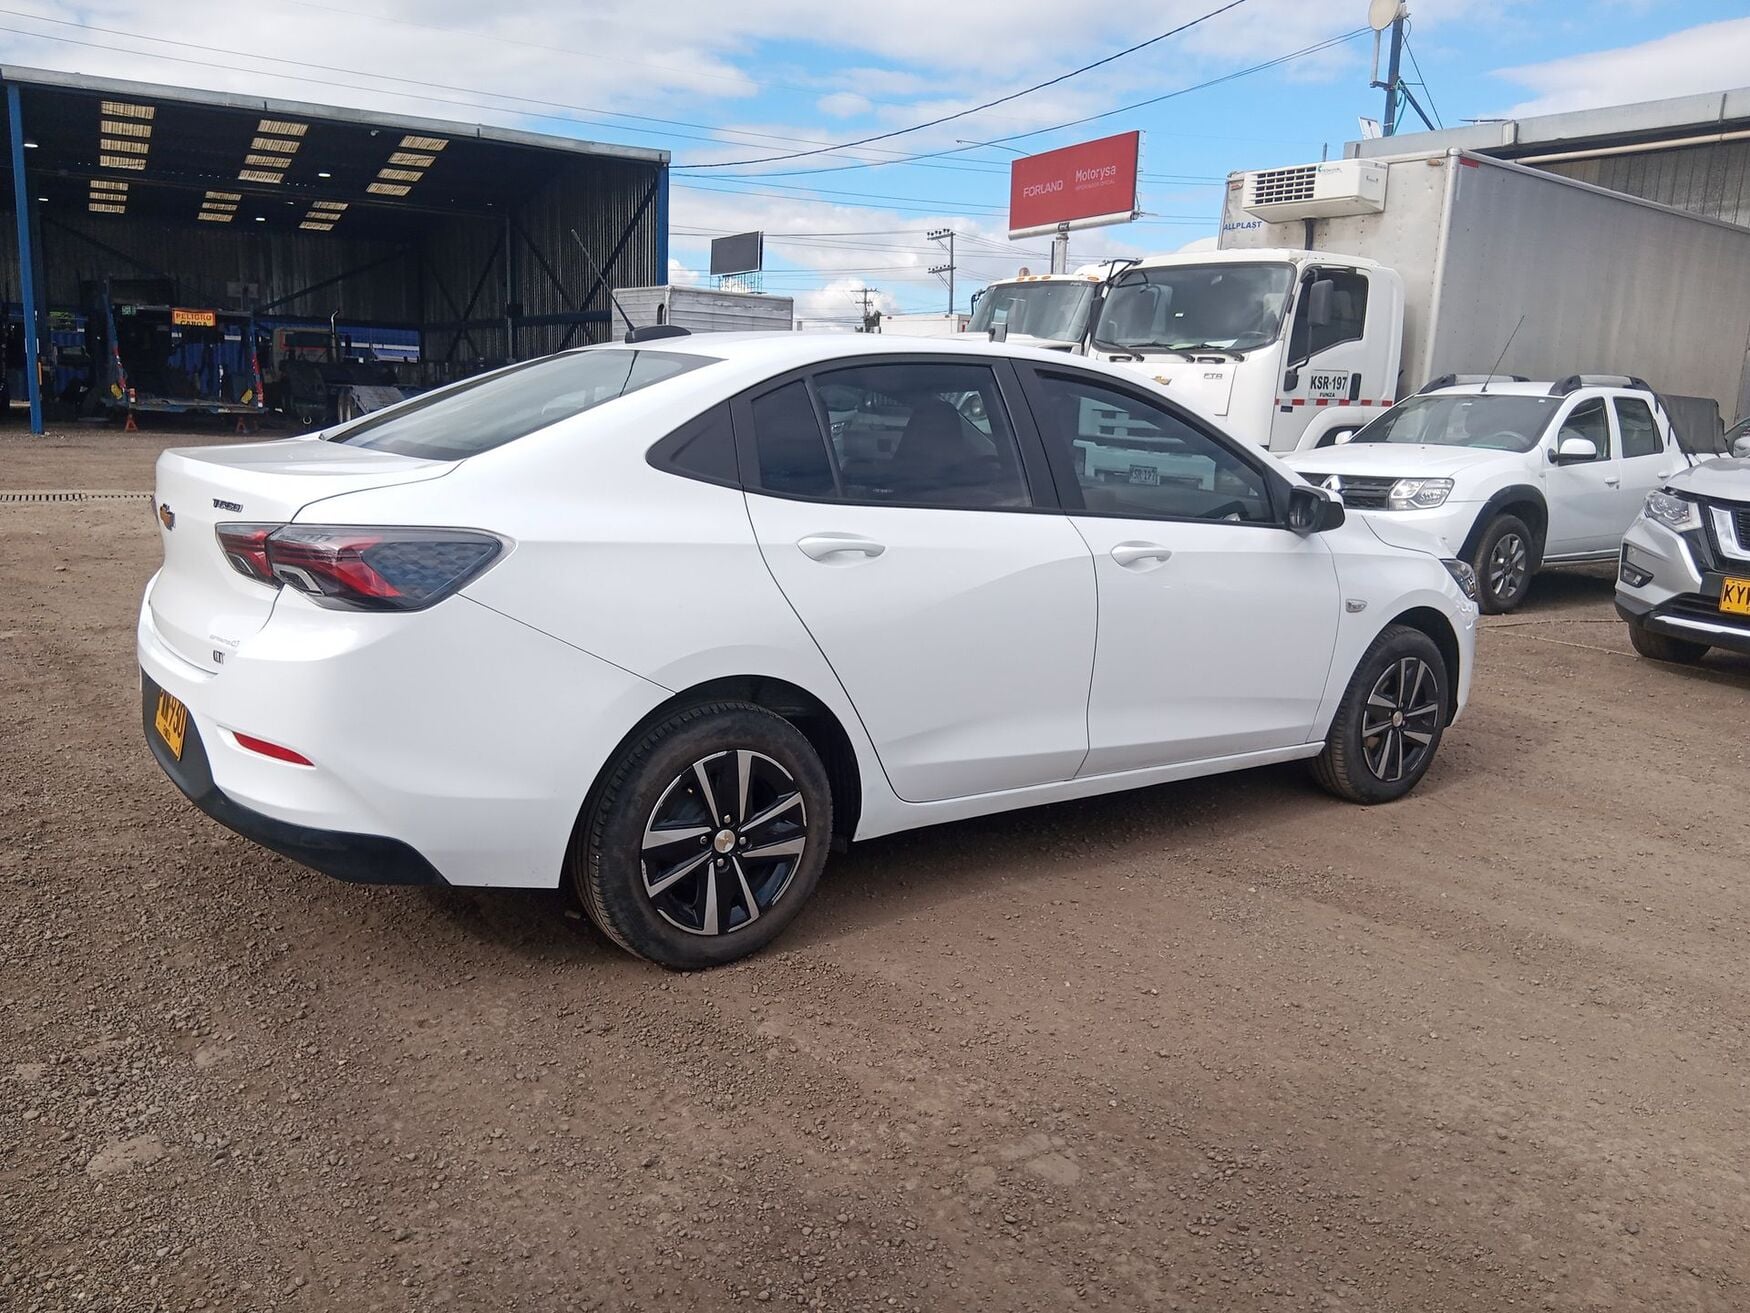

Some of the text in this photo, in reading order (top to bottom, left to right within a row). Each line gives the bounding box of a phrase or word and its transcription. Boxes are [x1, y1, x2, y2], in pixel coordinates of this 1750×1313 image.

[1075, 165, 1116, 182] Motorysa
[1023, 180, 1064, 198] FORLAND
[1223, 221, 1262, 231] ALLPLAST
[175, 312, 212, 321] PELIGRO
